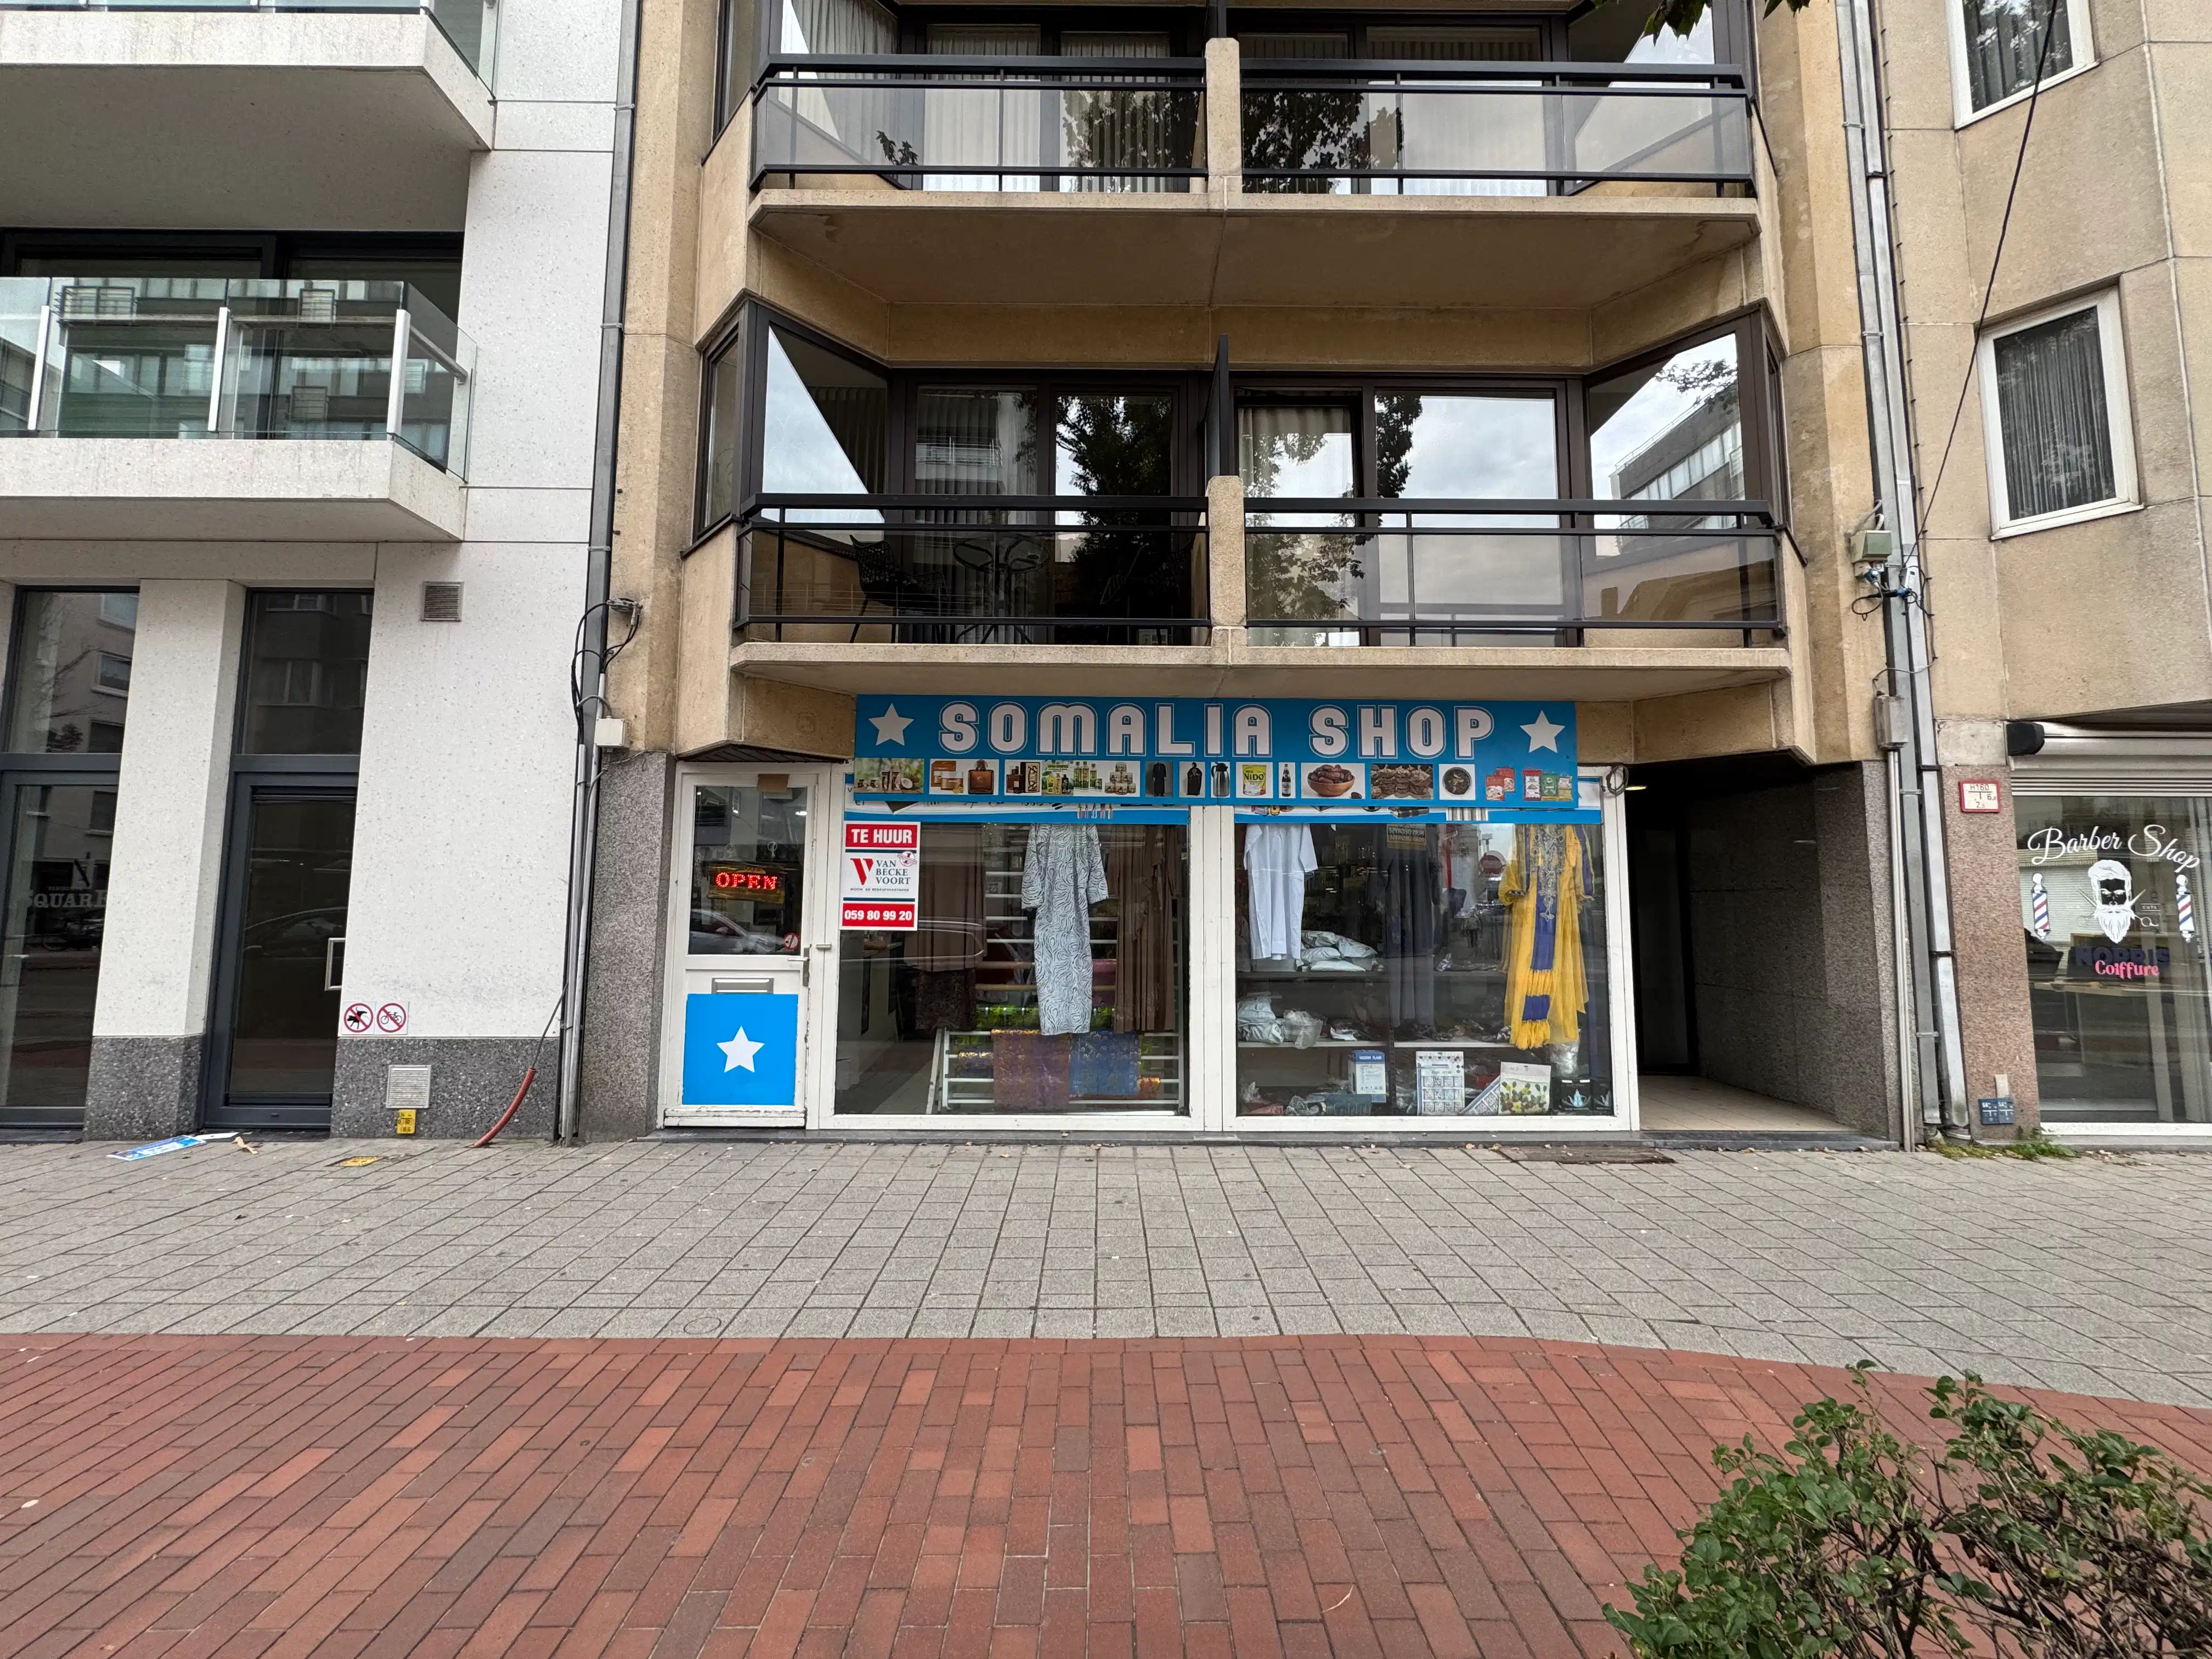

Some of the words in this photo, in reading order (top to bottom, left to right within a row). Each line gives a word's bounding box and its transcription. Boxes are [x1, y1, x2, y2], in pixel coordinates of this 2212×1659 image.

[939, 701, 1273, 757] SOMALIA
[1308, 704, 1494, 759] SHOP
[851, 829, 868, 843] TE
[873, 829, 912, 844] HUUR
[2027, 826, 2122, 865] Barber
[2128, 824, 2200, 873] Shop
[715, 872, 777, 890] OPEN
[845, 910, 865, 920] 059
[867, 910, 880, 921] 80
[883, 910, 896, 921] 99
[899, 910, 912, 921] 20
[2095, 960, 2160, 979] Coiffure
